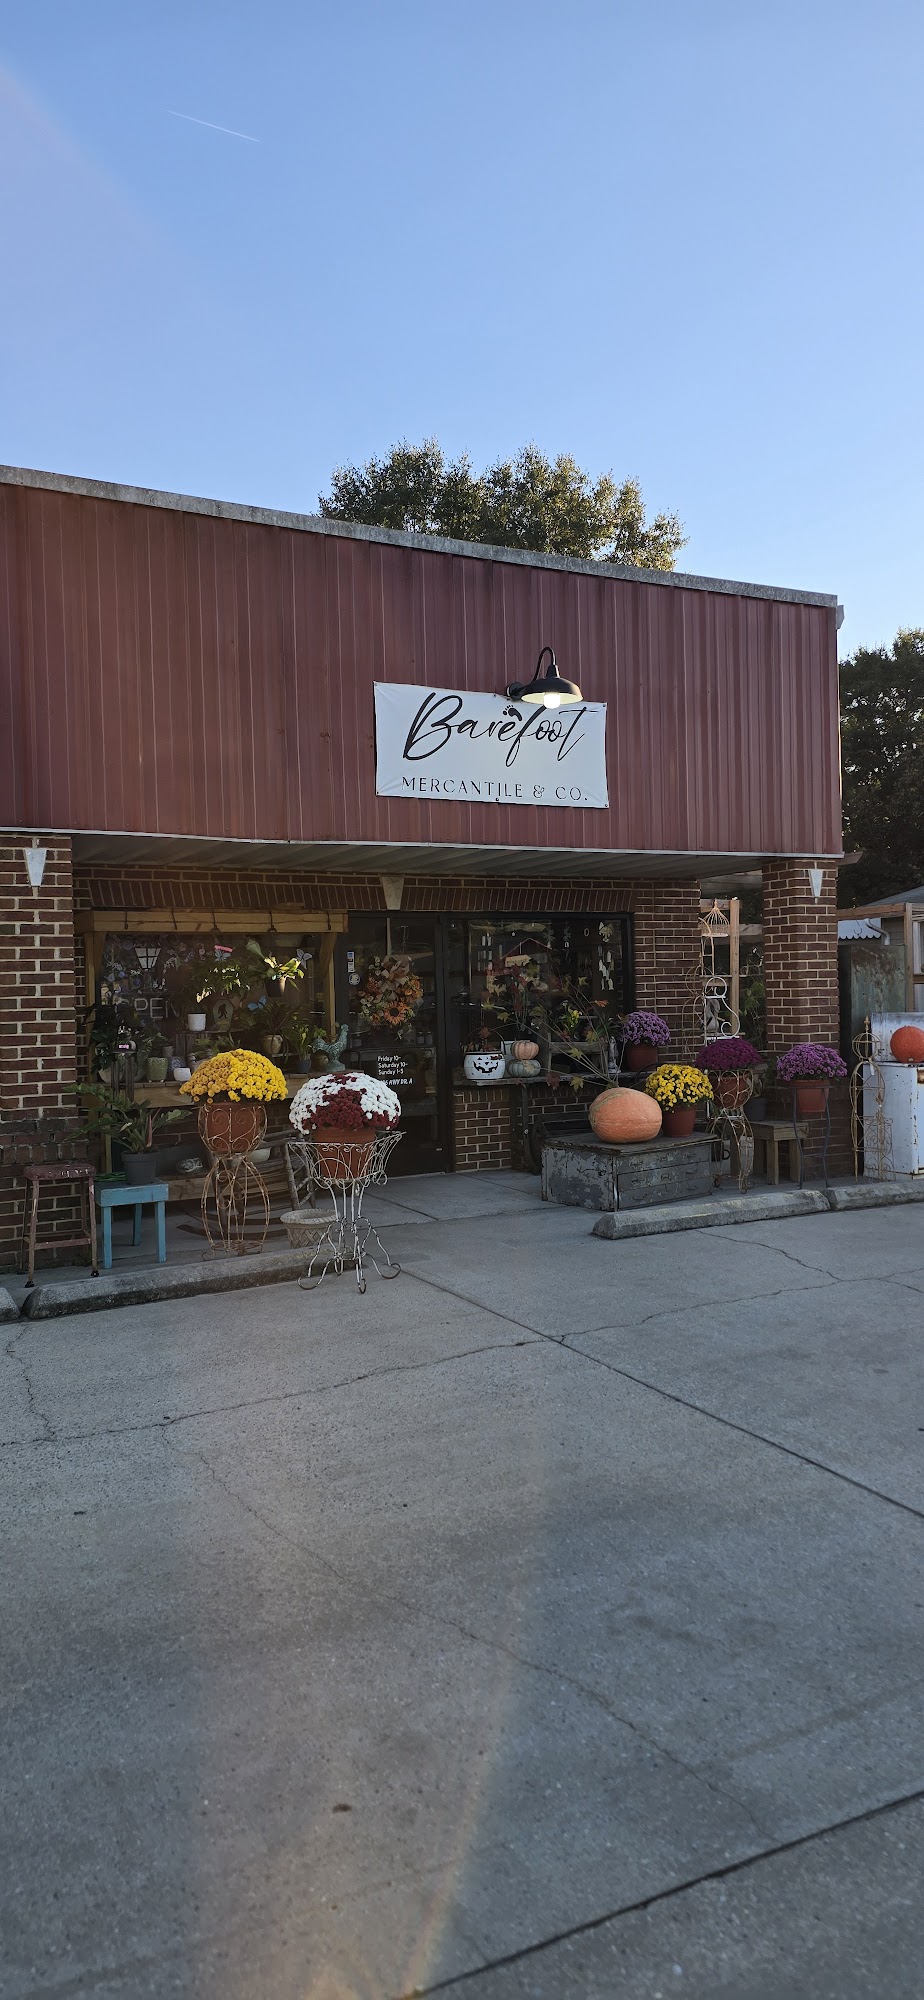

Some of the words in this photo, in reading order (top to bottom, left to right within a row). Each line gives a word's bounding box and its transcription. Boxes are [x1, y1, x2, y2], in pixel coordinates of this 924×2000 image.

[402, 692, 598, 767] Barefoot
[401, 776, 523, 799] MERCANTILE
[532, 785, 545, 799] &
[555, 786, 588, 801] CO.
